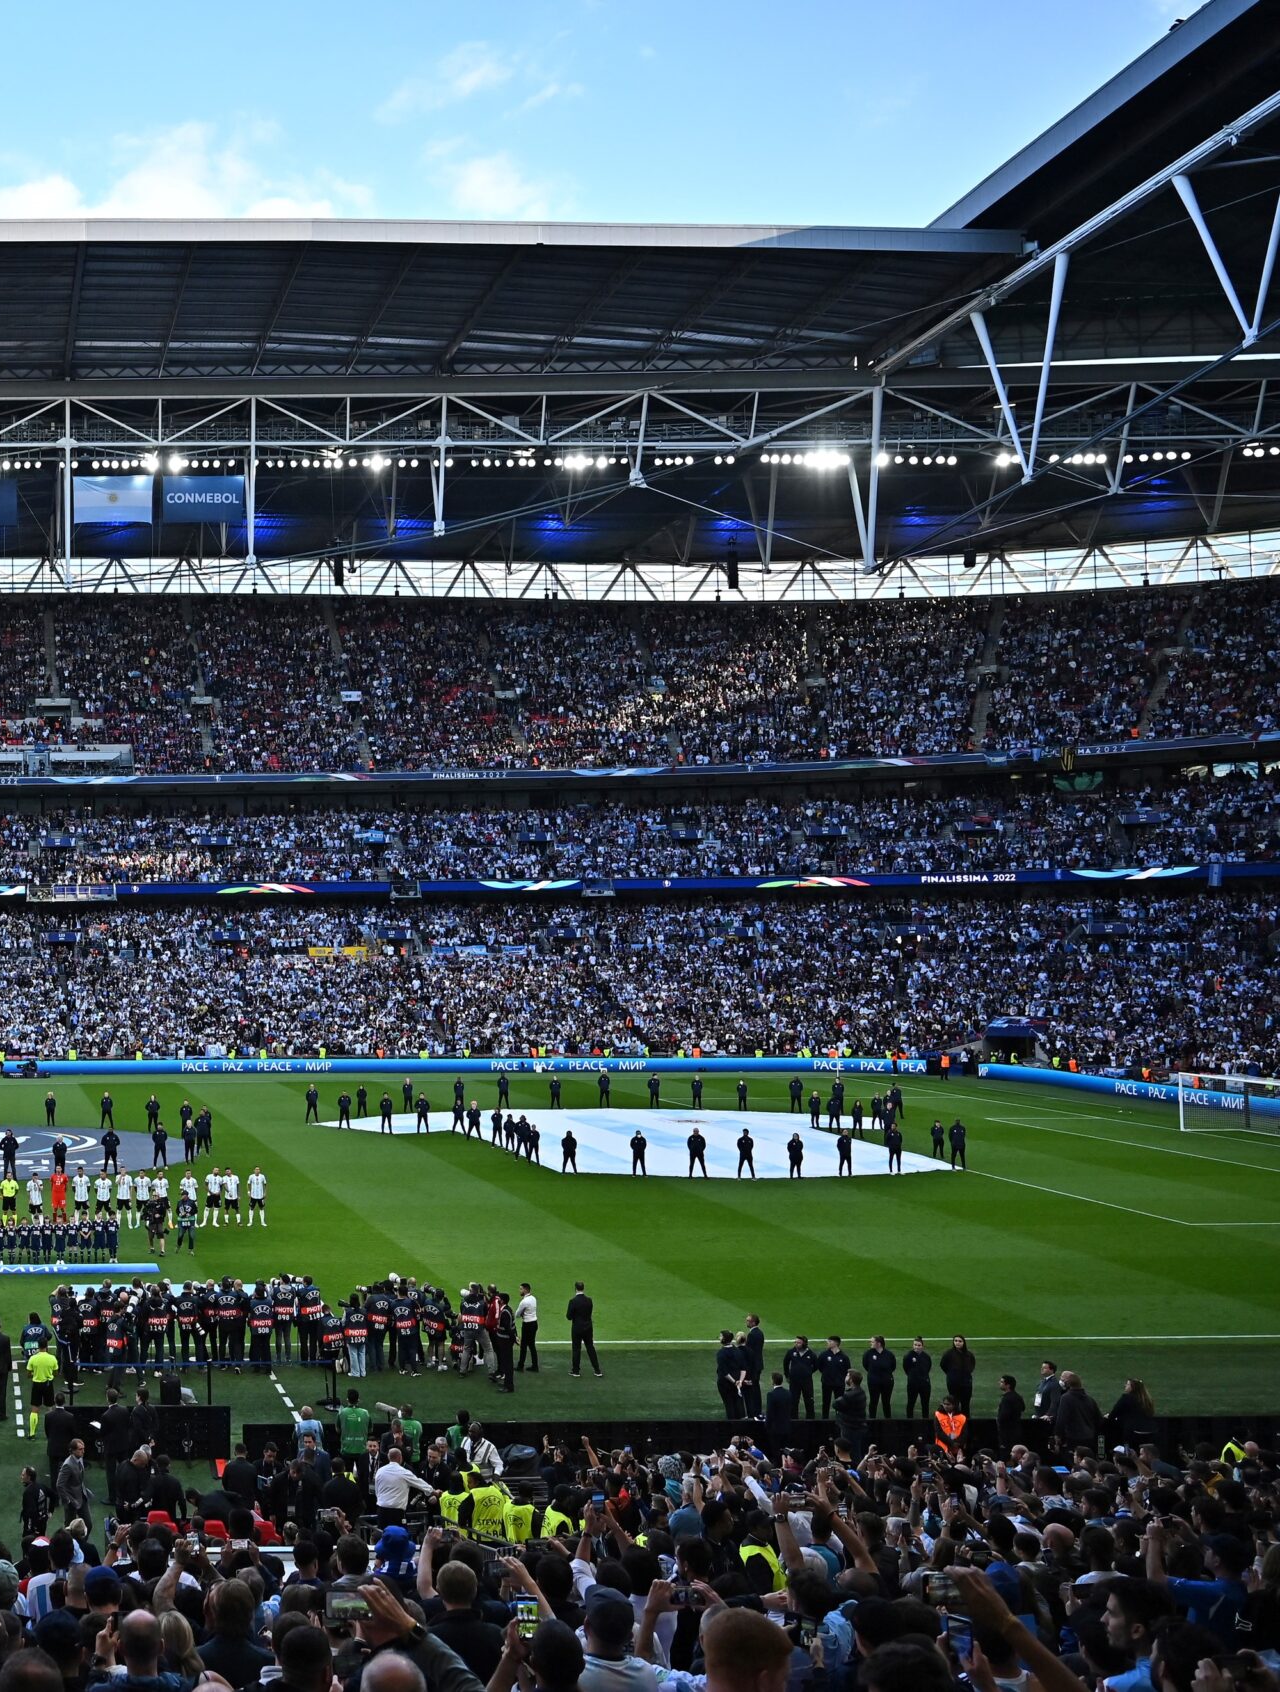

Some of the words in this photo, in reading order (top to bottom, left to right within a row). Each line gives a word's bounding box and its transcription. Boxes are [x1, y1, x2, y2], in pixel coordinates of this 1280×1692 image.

[166, 492, 240, 504] CONMEBOL
[921, 874, 989, 884] FINALISSIMA
[993, 873, 1016, 882] 2022
[181, 1061, 208, 1072] PACE
[222, 1061, 243, 1072] PAZ
[257, 1061, 292, 1072] PEACE
[305, 1061, 333, 1072] МИР
[491, 1060, 519, 1071] PACE
[533, 1060, 555, 1071] PAZ
[569, 1060, 605, 1071] PEACE
[619, 1060, 646, 1071] МИР
[814, 1060, 844, 1071] PACE
[860, 1061, 885, 1071] PAZ
[901, 1062, 926, 1072] PEA
[1115, 1082, 1138, 1096] PACE
[1148, 1086, 1166, 1099] PAZ
[219, 1295, 236, 1305] UEFA
[276, 1292, 293, 1300] UEFA
[305, 1290, 320, 1300] UEFA
[254, 1305, 271, 1315] UEFA
[393, 1306, 410, 1316] UEFA
[350, 1314, 365, 1323] UEFA
